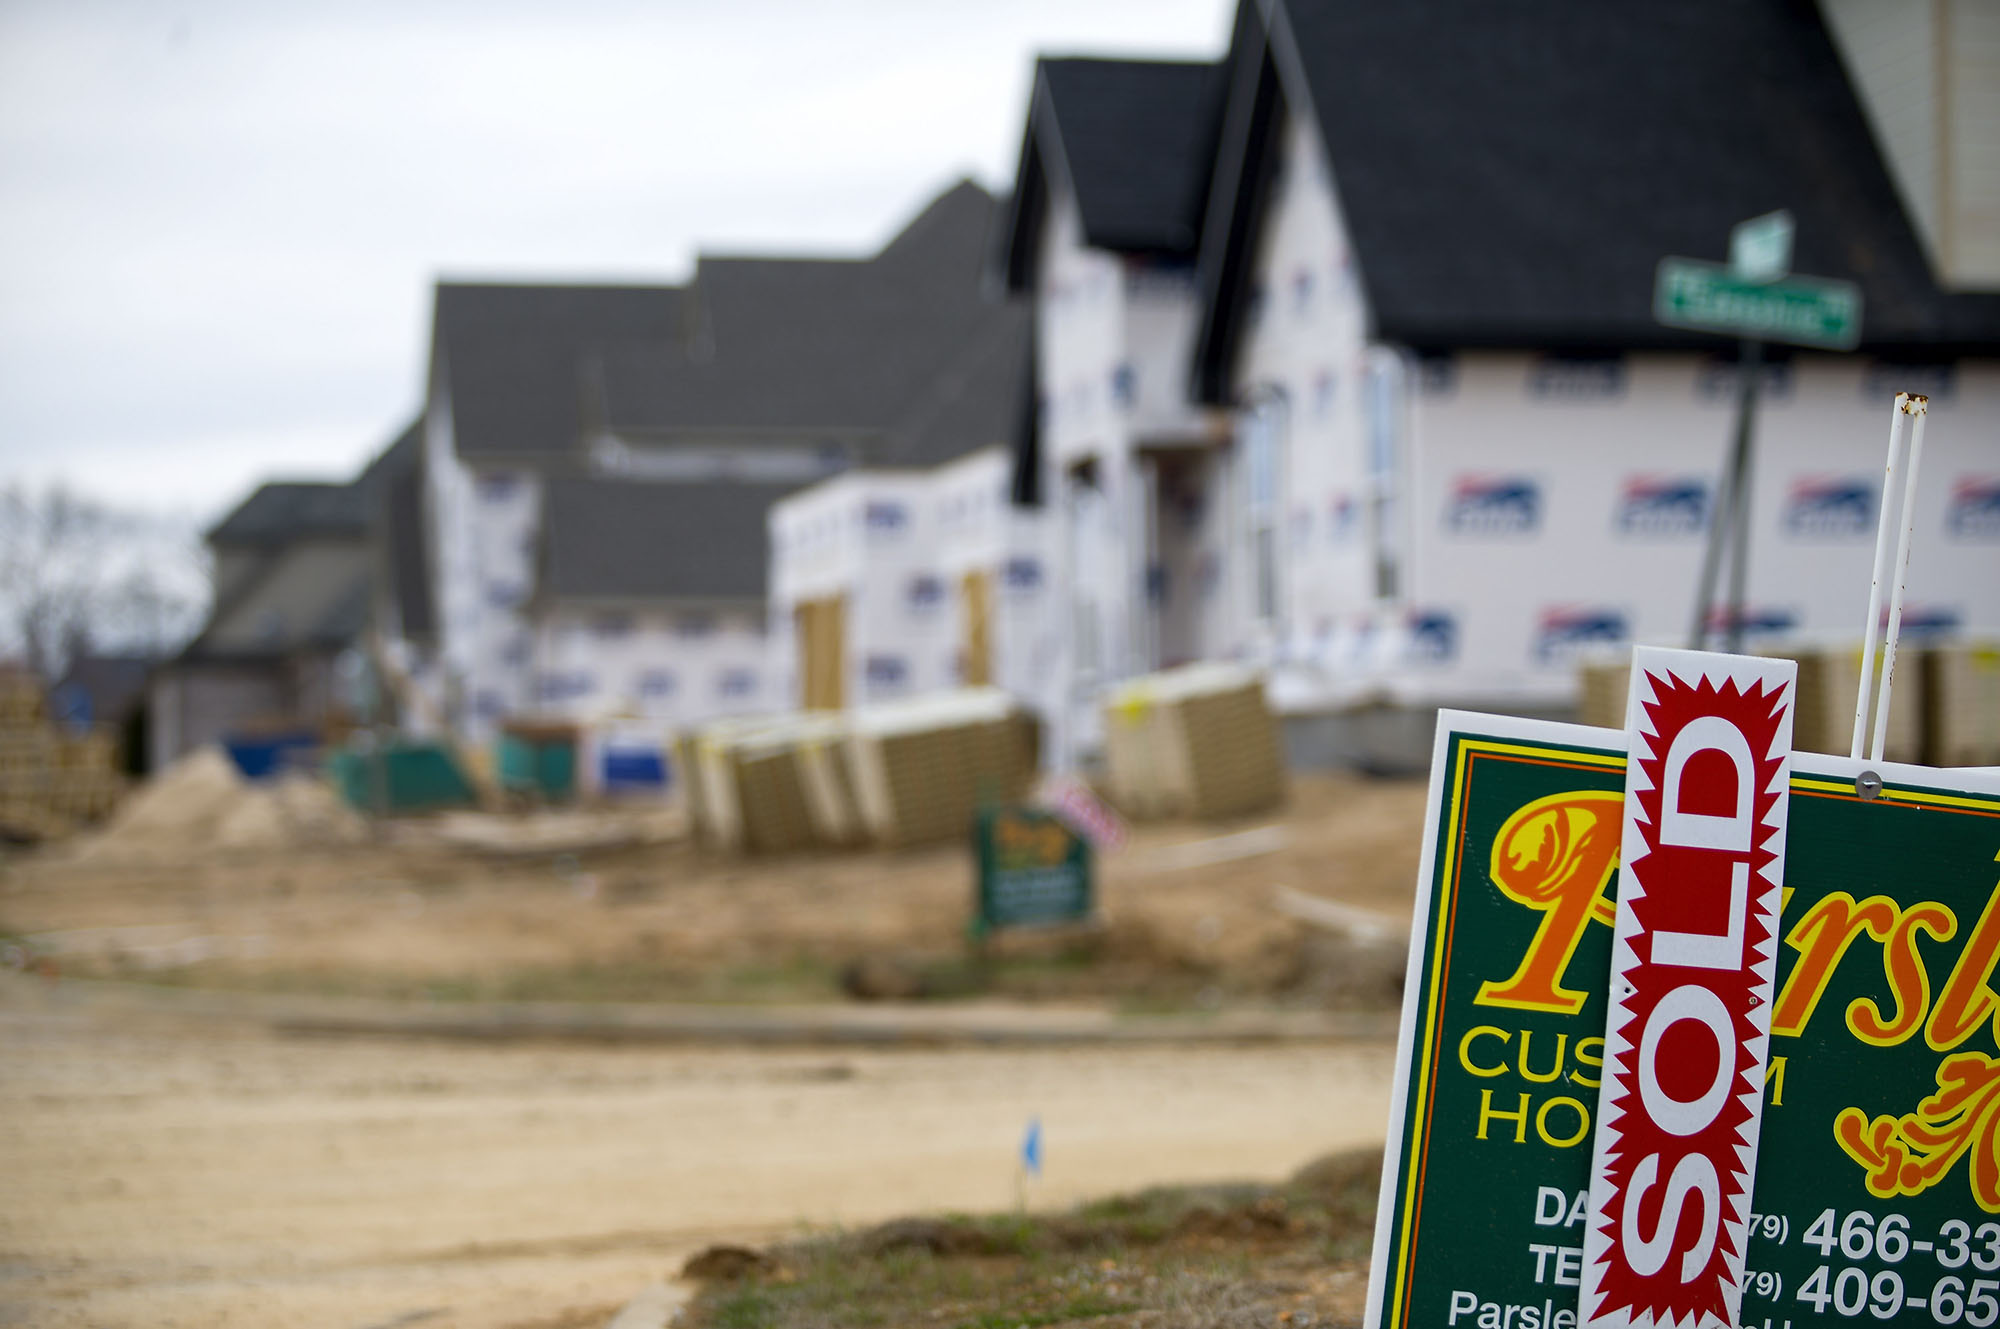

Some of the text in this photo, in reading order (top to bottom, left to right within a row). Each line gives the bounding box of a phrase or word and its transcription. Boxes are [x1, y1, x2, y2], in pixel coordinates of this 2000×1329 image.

[1473, 790, 2000, 1052] Prsl
[1622, 716, 1755, 1284] SOLD
[1475, 1089, 1591, 1148] HO
[1534, 1186, 1590, 1228] DA
[1747, 1213, 1789, 1245] 79)
[1528, 1243, 1584, 1286] TE
[1741, 1270, 1783, 1302] 79)
[1449, 1290, 1577, 1329] Parsle
